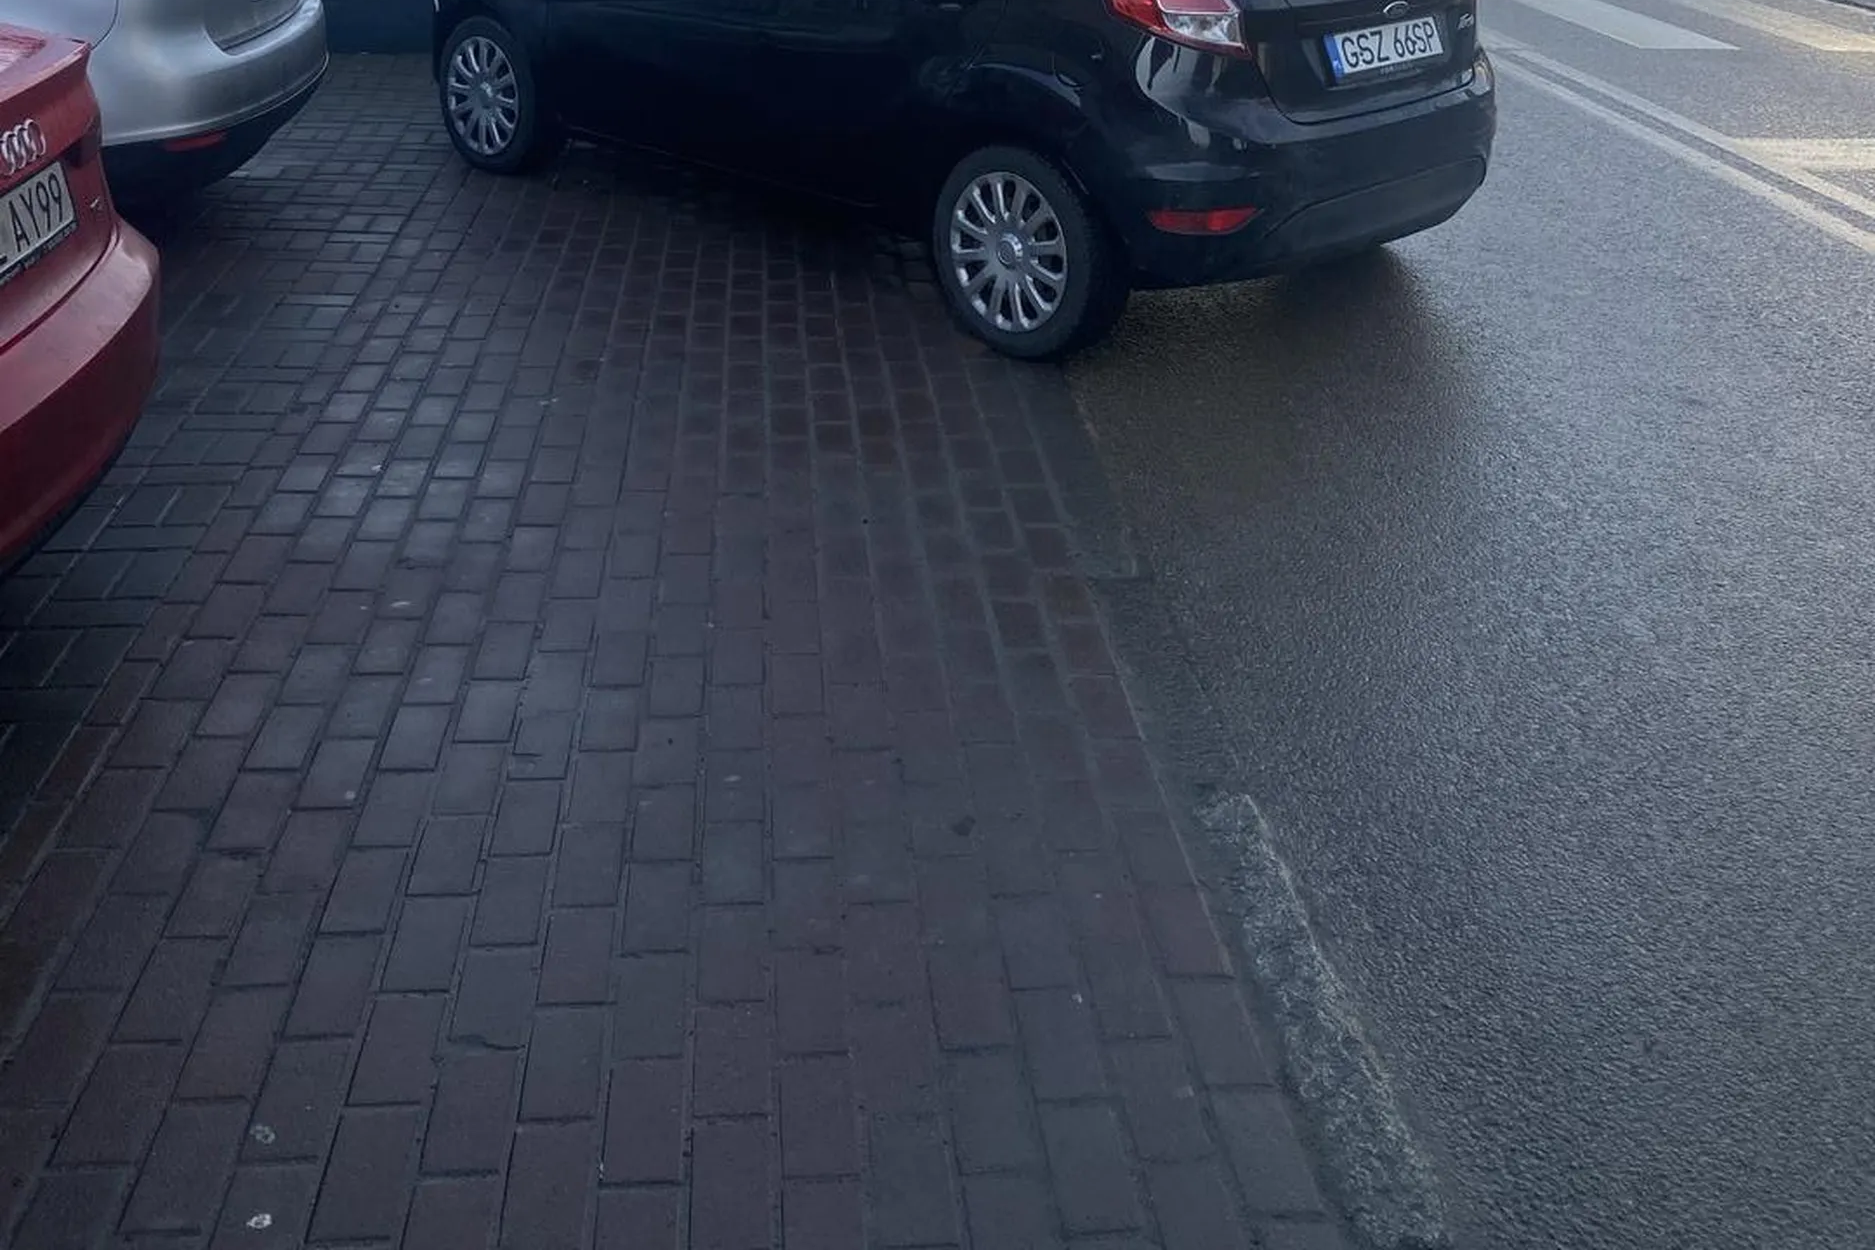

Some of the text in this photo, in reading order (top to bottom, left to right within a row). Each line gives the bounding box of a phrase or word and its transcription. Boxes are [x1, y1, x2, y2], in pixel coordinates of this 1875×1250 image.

[1341, 30, 1389, 68] GSZ
[1393, 21, 1434, 58] 66SP
[8, 173, 63, 252] AY99
